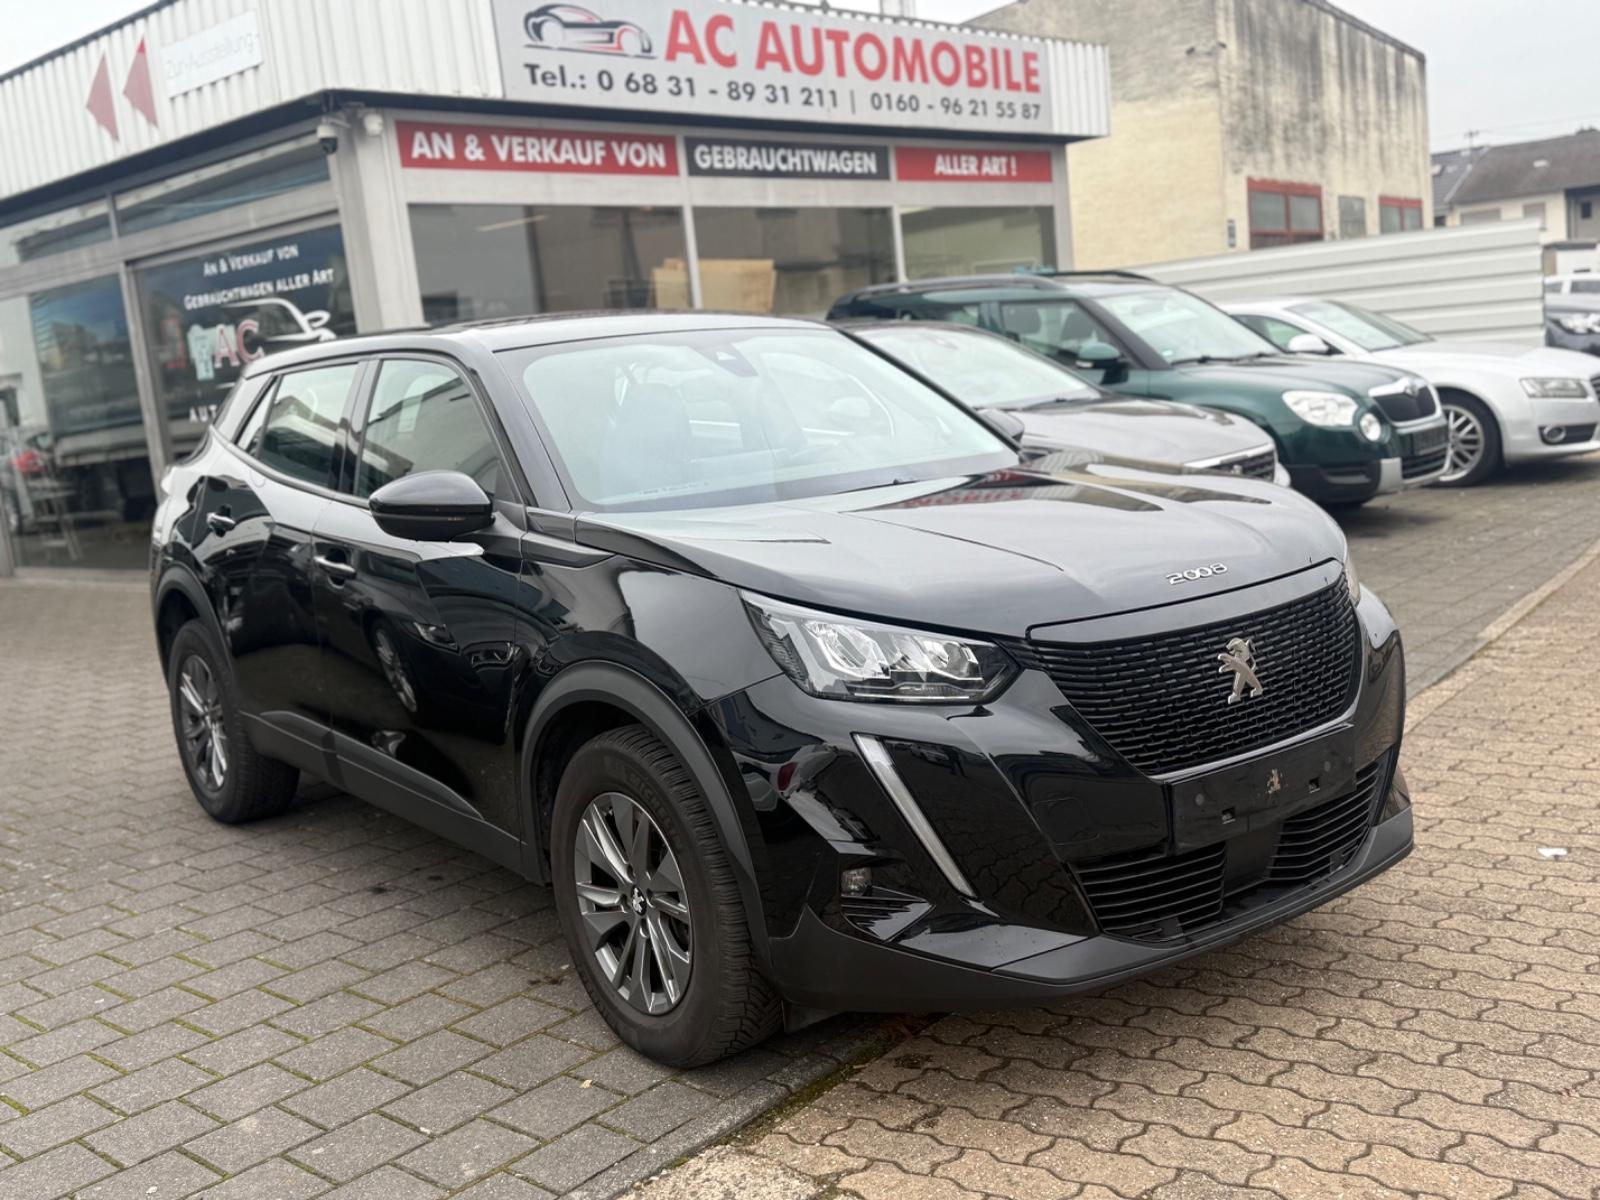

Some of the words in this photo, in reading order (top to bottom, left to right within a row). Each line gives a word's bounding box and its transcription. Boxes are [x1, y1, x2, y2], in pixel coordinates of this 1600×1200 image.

[664, 9, 738, 69] AC
[755, 21, 1041, 93] AUTOMOBILE
[523, 63, 587, 90] Tel.:
[597, 70, 614, 92] 0
[624, 72, 659, 95] 68
[667, 75, 697, 97] 31
[727, 80, 756, 102] 89
[765, 84, 790, 105] 31
[801, 87, 839, 108] 211
[870, 92, 920, 113] 0160
[940, 97, 963, 115] 96
[970, 99, 988, 117] 21
[996, 101, 1017, 119] 55
[1022, 103, 1041, 120] 87
[411, 131, 455, 160] AN
[465, 133, 486, 162] &
[491, 134, 606, 166] VERKAUF
[611, 140, 667, 168] VON
[694, 144, 877, 174] GEBRAUCHTWAGEN
[935, 153, 978, 176] ALLER
[980, 154, 1008, 176] ART
[1011, 155, 1017, 176] !
[219, 258, 228, 273] &
[214, 319, 265, 368] AC
[1165, 562, 1228, 585] 2008
